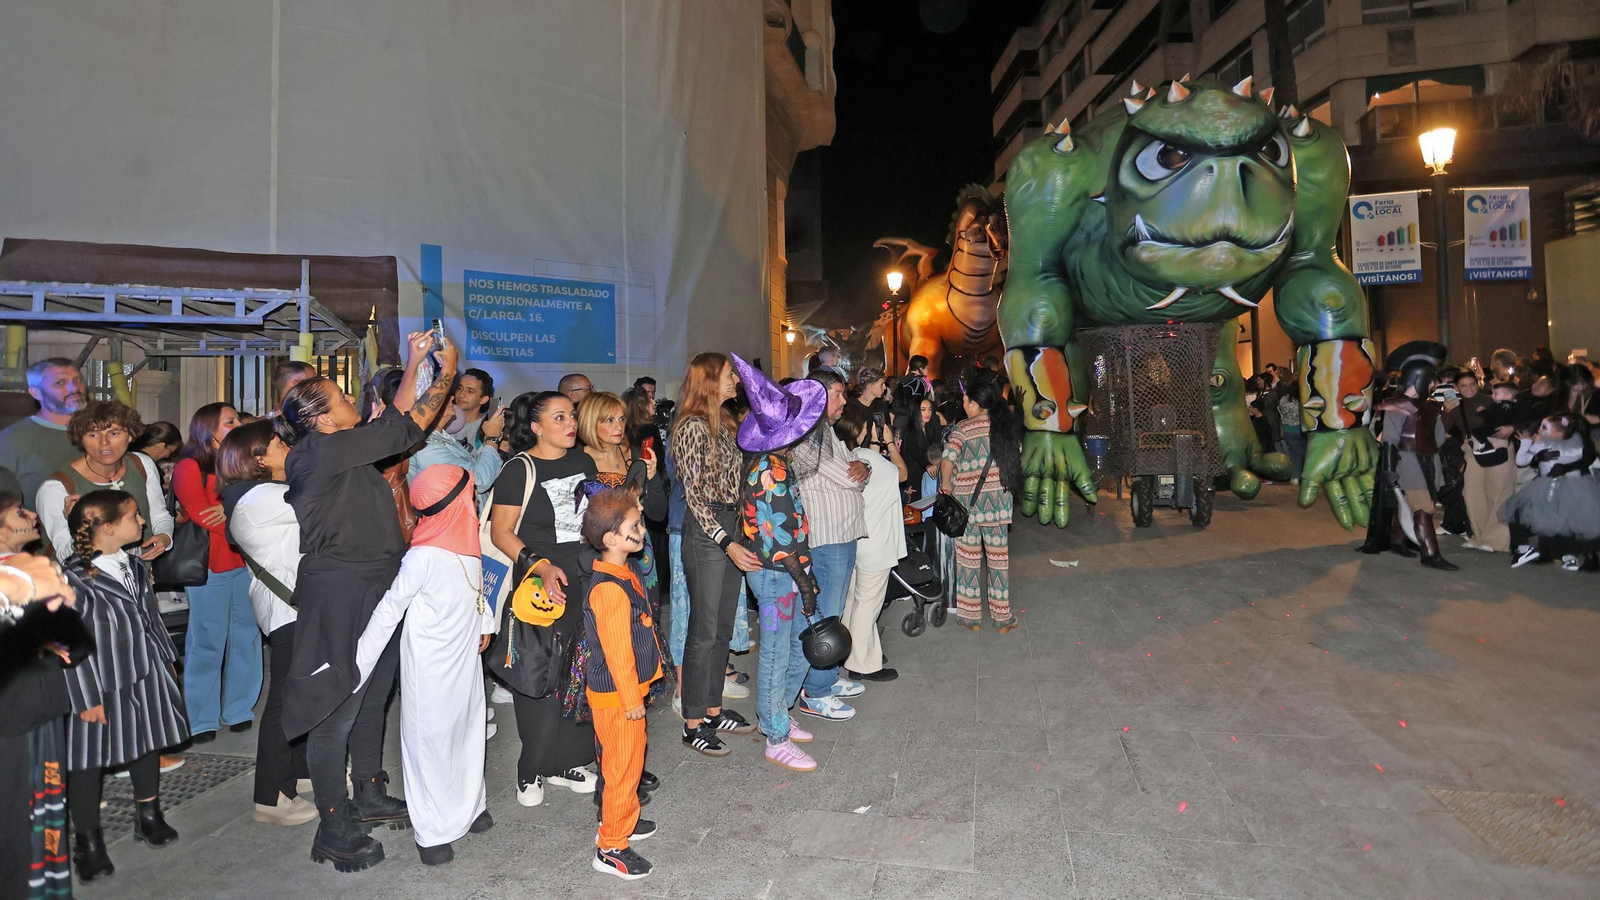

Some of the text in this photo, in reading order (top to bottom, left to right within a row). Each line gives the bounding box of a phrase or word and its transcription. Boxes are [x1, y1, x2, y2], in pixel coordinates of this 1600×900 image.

[1358, 273, 1416, 284] ¡VISÍTANOS!
[1470, 270, 1527, 279] ¡VISÍTANOS!
[469, 279, 610, 298] NOS HEMOS TRASLADADO
[469, 294, 592, 311] PROVISIONALMENTE A
[469, 309, 544, 322] C/ LARGA, 16.
[471, 330, 556, 343] DISCULPEN LAS
[471, 346, 534, 357] MOLESTIAS
[484, 570, 498, 586] UNA
